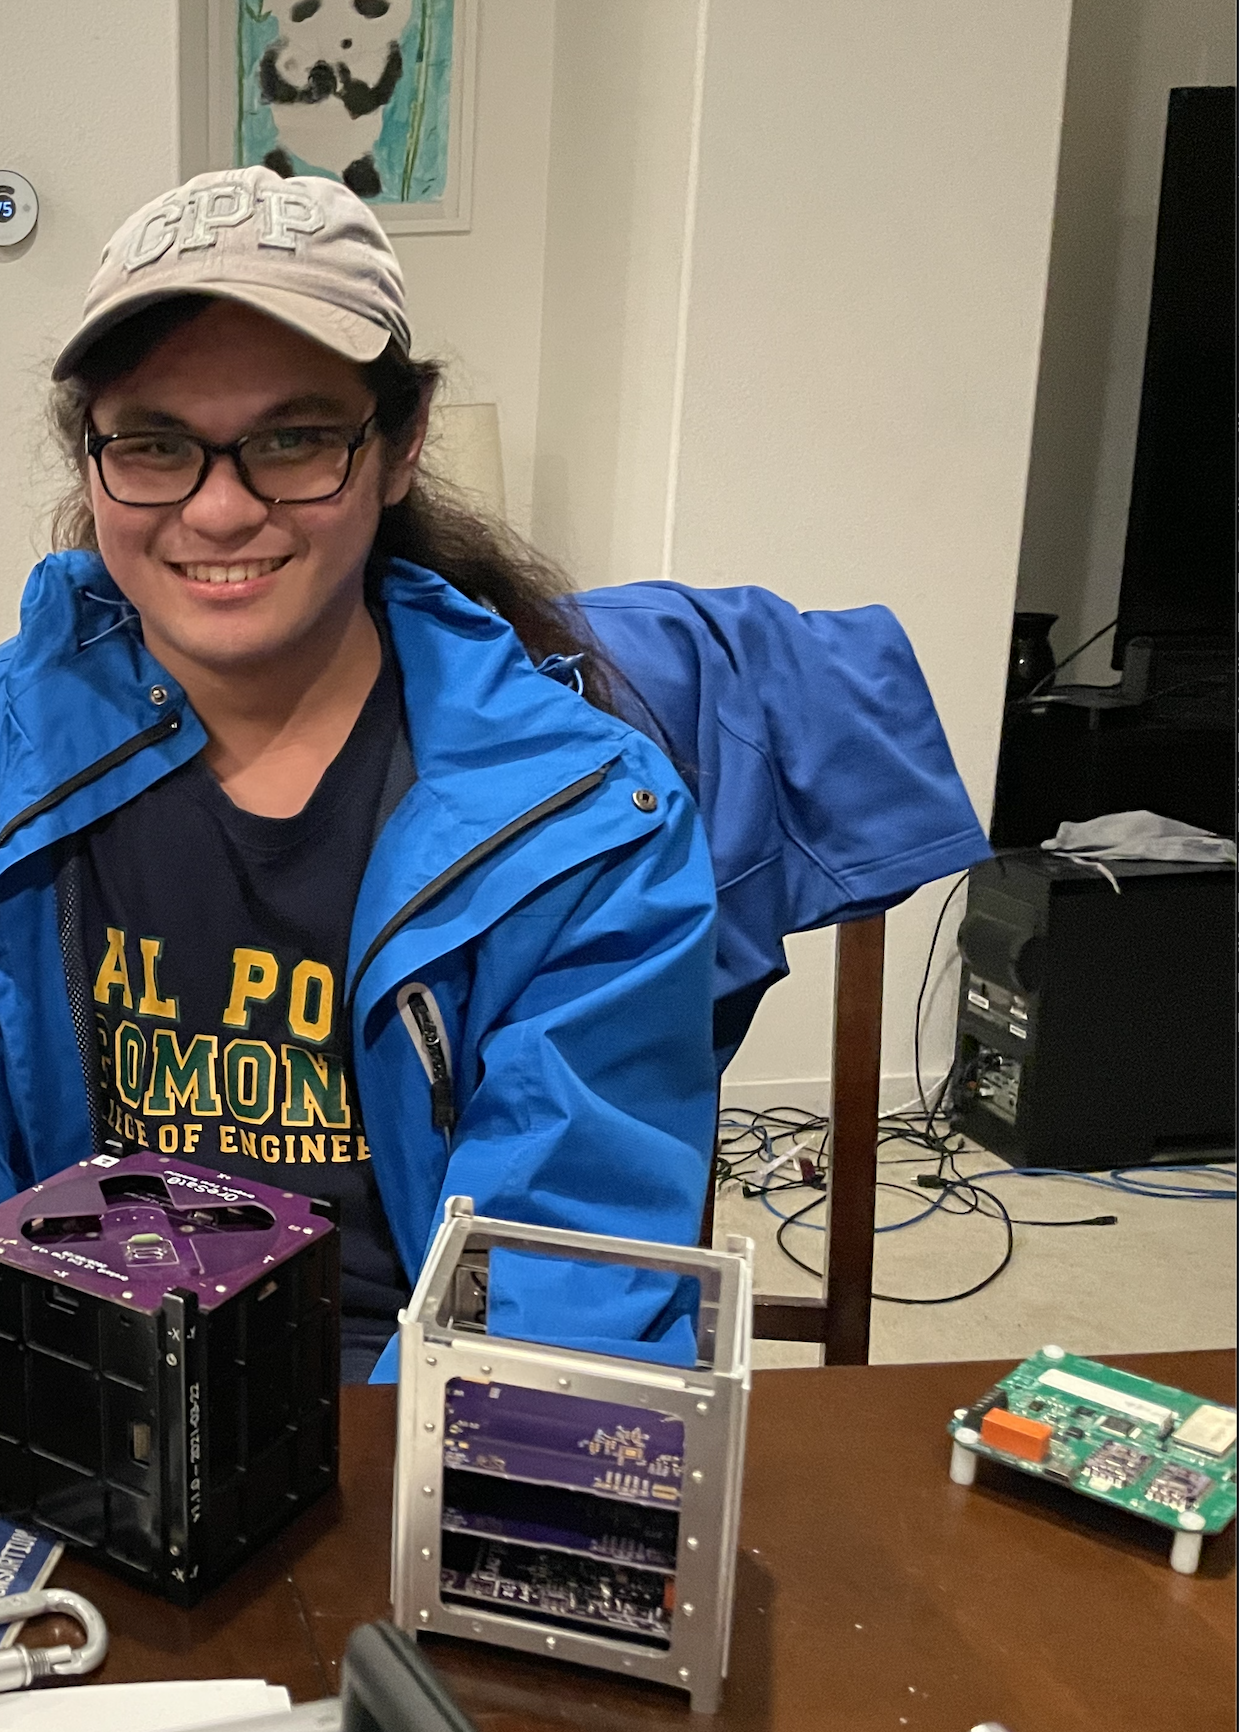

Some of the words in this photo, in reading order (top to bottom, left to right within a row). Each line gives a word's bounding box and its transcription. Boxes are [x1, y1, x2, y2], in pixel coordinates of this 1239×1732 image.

[123, 180, 327, 274] CPP
[92, 926, 180, 1020] AL
[221, 946, 336, 1043] PO
[96, 1012, 351, 1130] OMON
[102, 1098, 150, 1148] LEGE
[158, 1123, 203, 1154] OF
